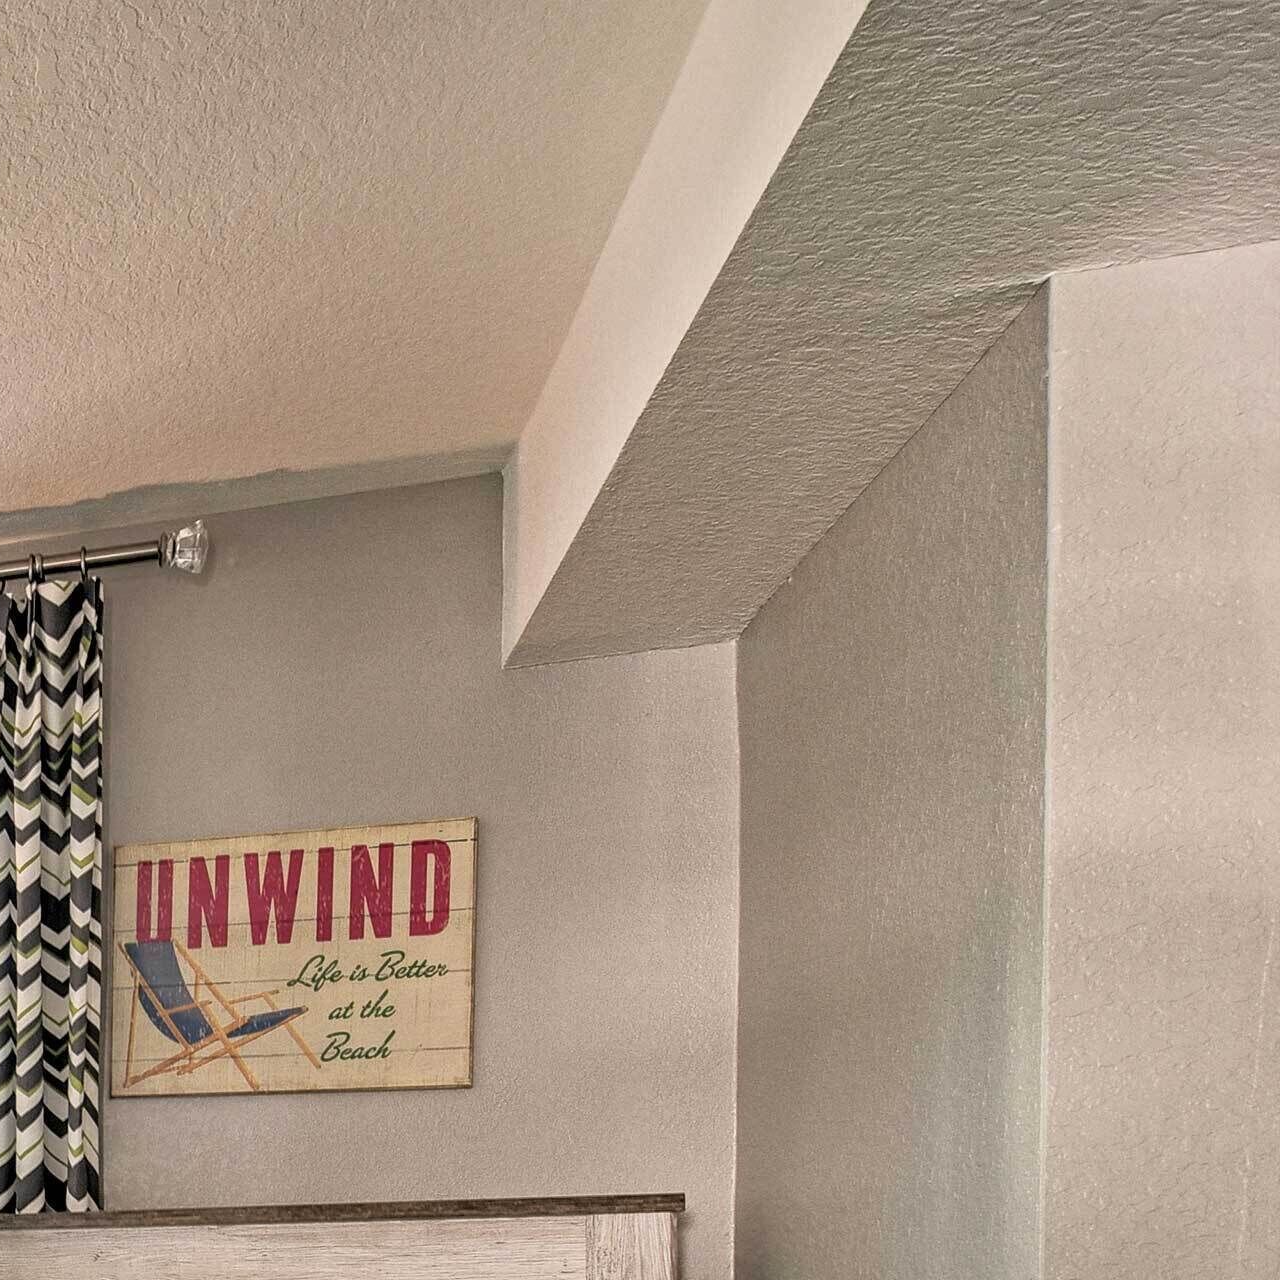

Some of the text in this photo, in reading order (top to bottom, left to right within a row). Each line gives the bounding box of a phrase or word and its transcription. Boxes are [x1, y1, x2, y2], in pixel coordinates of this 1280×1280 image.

[135, 838, 452, 949] UNWIND
[286, 950, 449, 992] Life is Better
[327, 989, 396, 1020] at the
[320, 1029, 396, 1062] Beach
